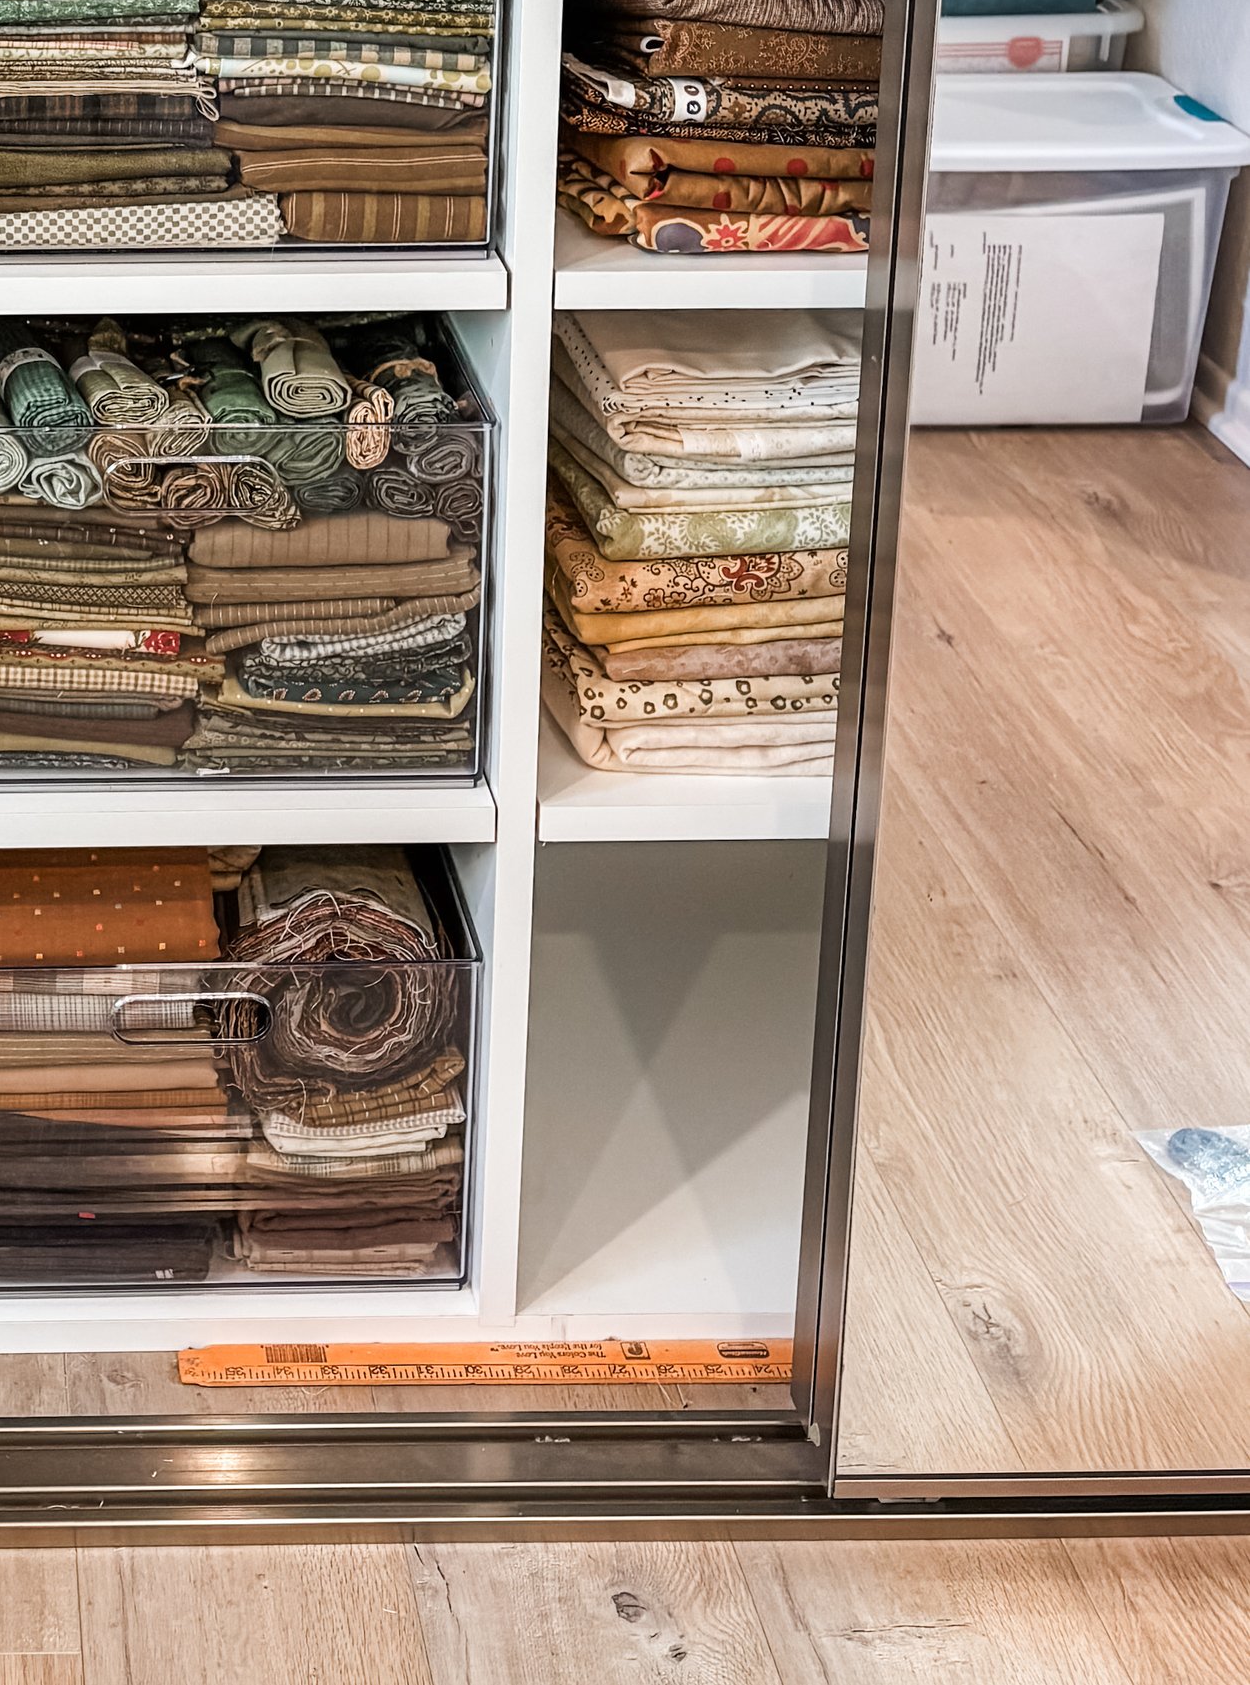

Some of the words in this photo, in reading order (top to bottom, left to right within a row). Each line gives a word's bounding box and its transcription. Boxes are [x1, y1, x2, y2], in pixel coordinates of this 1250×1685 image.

[523, 1344, 541, 1352] You
[572, 1343, 588, 1351] the
[589, 1343, 603, 1351] for
[539, 1351, 557, 1359] You
[557, 1351, 587, 1359] Colors
[587, 1351, 607, 1359] The
[275, 1365, 291, 1374] 34
[322, 1365, 339, 1374] 33
[370, 1365, 387, 1374] 32
[418, 1365, 435, 1374] 31
[466, 1365, 483, 1374] 30
[515, 1365, 532, 1374] 29
[562, 1365, 579, 1374] 28
[611, 1365, 627, 1374] 27
[658, 1365, 675, 1374] 26
[706, 1365, 723, 1374] 25
[754, 1365, 771, 1374] 24
